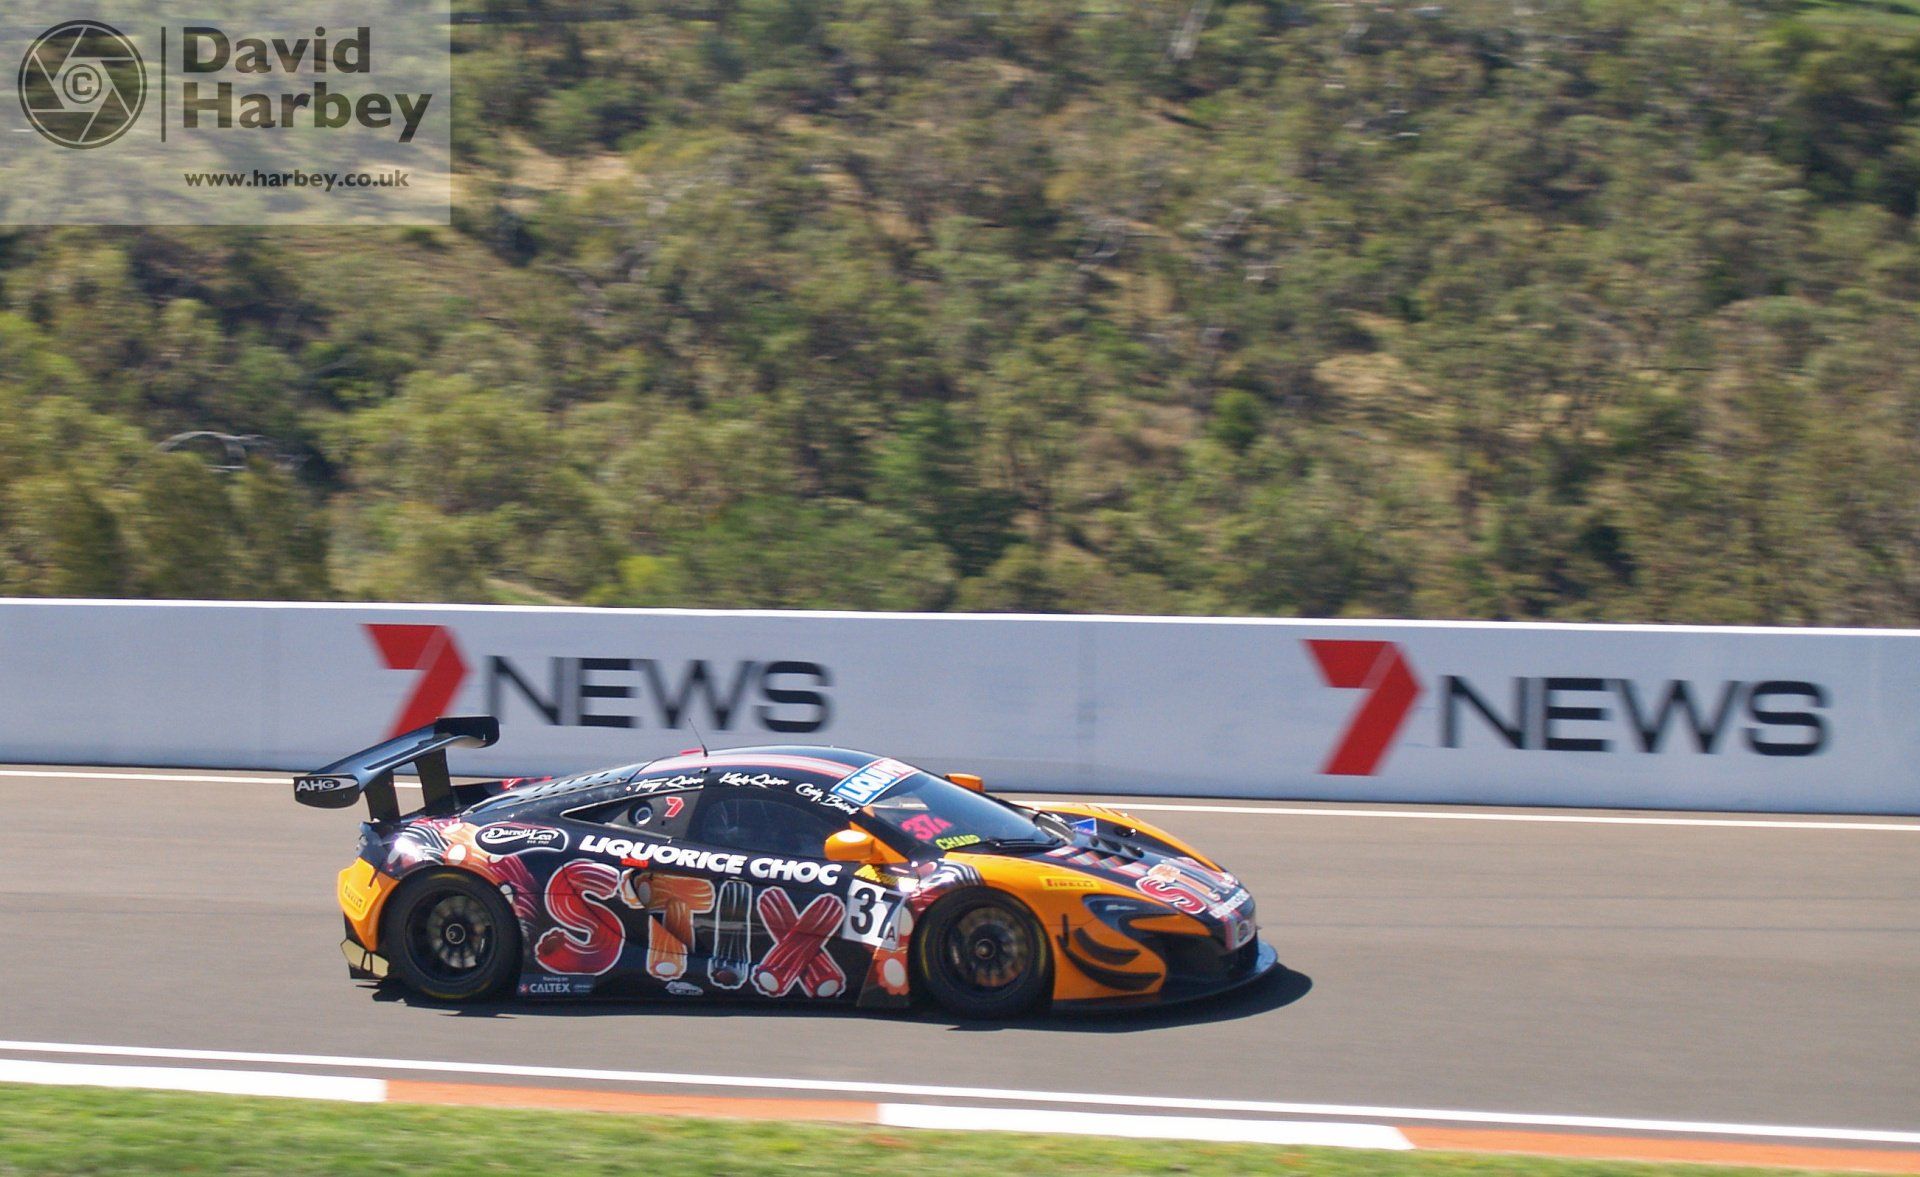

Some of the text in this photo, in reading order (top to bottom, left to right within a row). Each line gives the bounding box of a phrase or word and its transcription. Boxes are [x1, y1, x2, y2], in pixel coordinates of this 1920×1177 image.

[485, 654, 832, 734] NEWS
[1440, 674, 1829, 757] NEWS
[296, 779, 335, 792] AHG
[579, 835, 842, 886] LIQUORICE CHOC
[935, 834, 981, 850] CHAMP
[535, 858, 847, 997] STIX
[851, 887, 904, 938] 37
[886, 926, 896, 942] A
[529, 983, 571, 993] CALTEX
